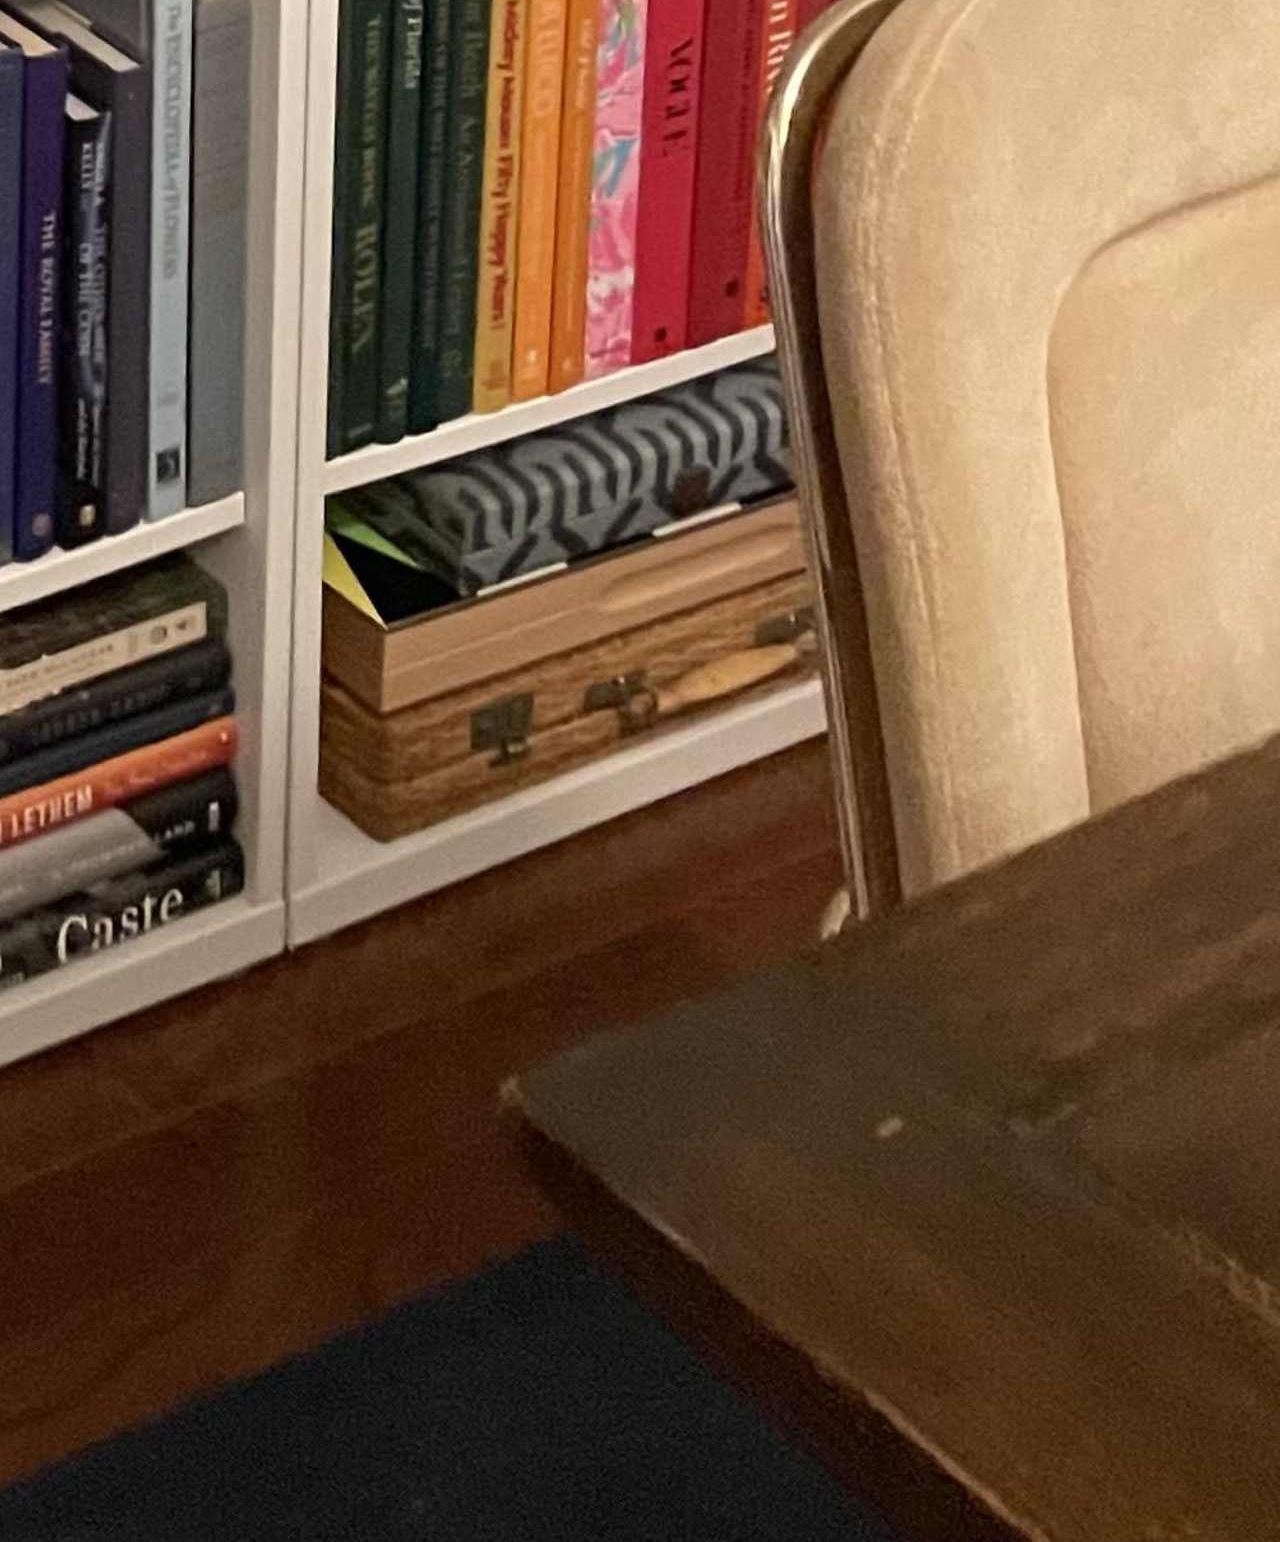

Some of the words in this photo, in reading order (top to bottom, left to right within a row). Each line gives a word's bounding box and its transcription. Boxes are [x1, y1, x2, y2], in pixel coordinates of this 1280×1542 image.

[403, 16, 424, 90] Florida
[498, 0, 519, 69] Mickey
[662, 36, 694, 158] VOGUE
[42, 213, 57, 252] THE
[489, 203, 511, 266] Happy
[351, 221, 378, 355] ROLEX
[11, 785, 94, 838] LETHEM
[56, 884, 184, 964] Caste
